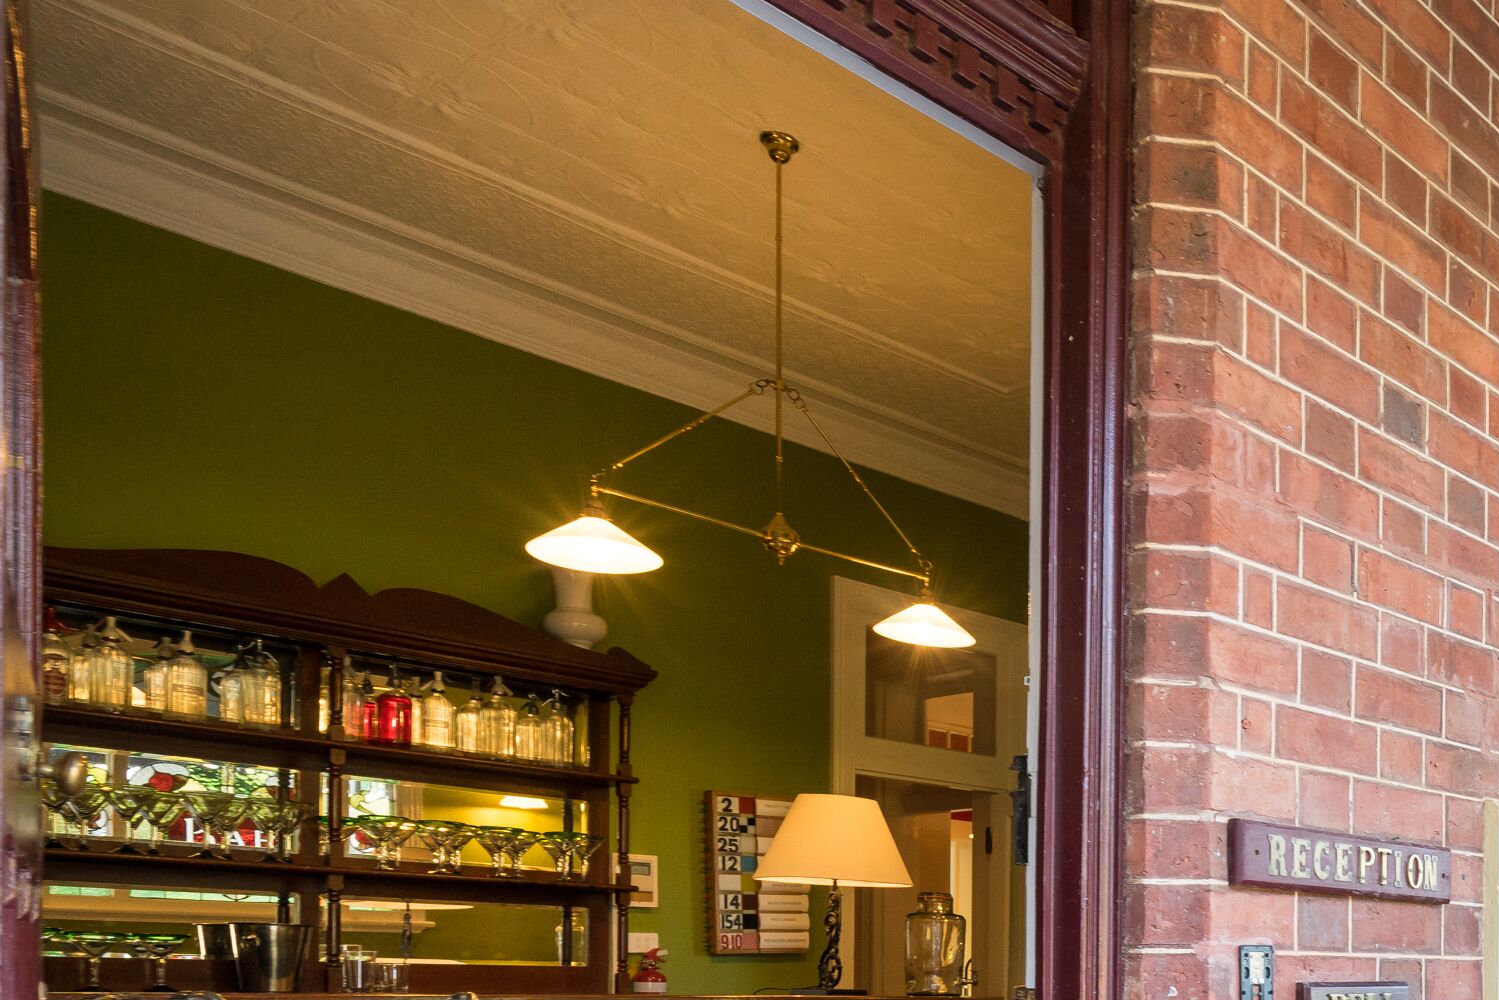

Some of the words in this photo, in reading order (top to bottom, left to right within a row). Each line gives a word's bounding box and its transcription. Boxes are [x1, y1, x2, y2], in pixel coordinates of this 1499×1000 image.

[720, 798, 733, 813] 2
[718, 816, 740, 832] 20
[718, 838, 739, 853] 25
[720, 855, 738, 872] 12
[1266, 833, 1440, 891] RECEPTION
[723, 894, 741, 910] 14
[721, 914, 743, 930] 154
